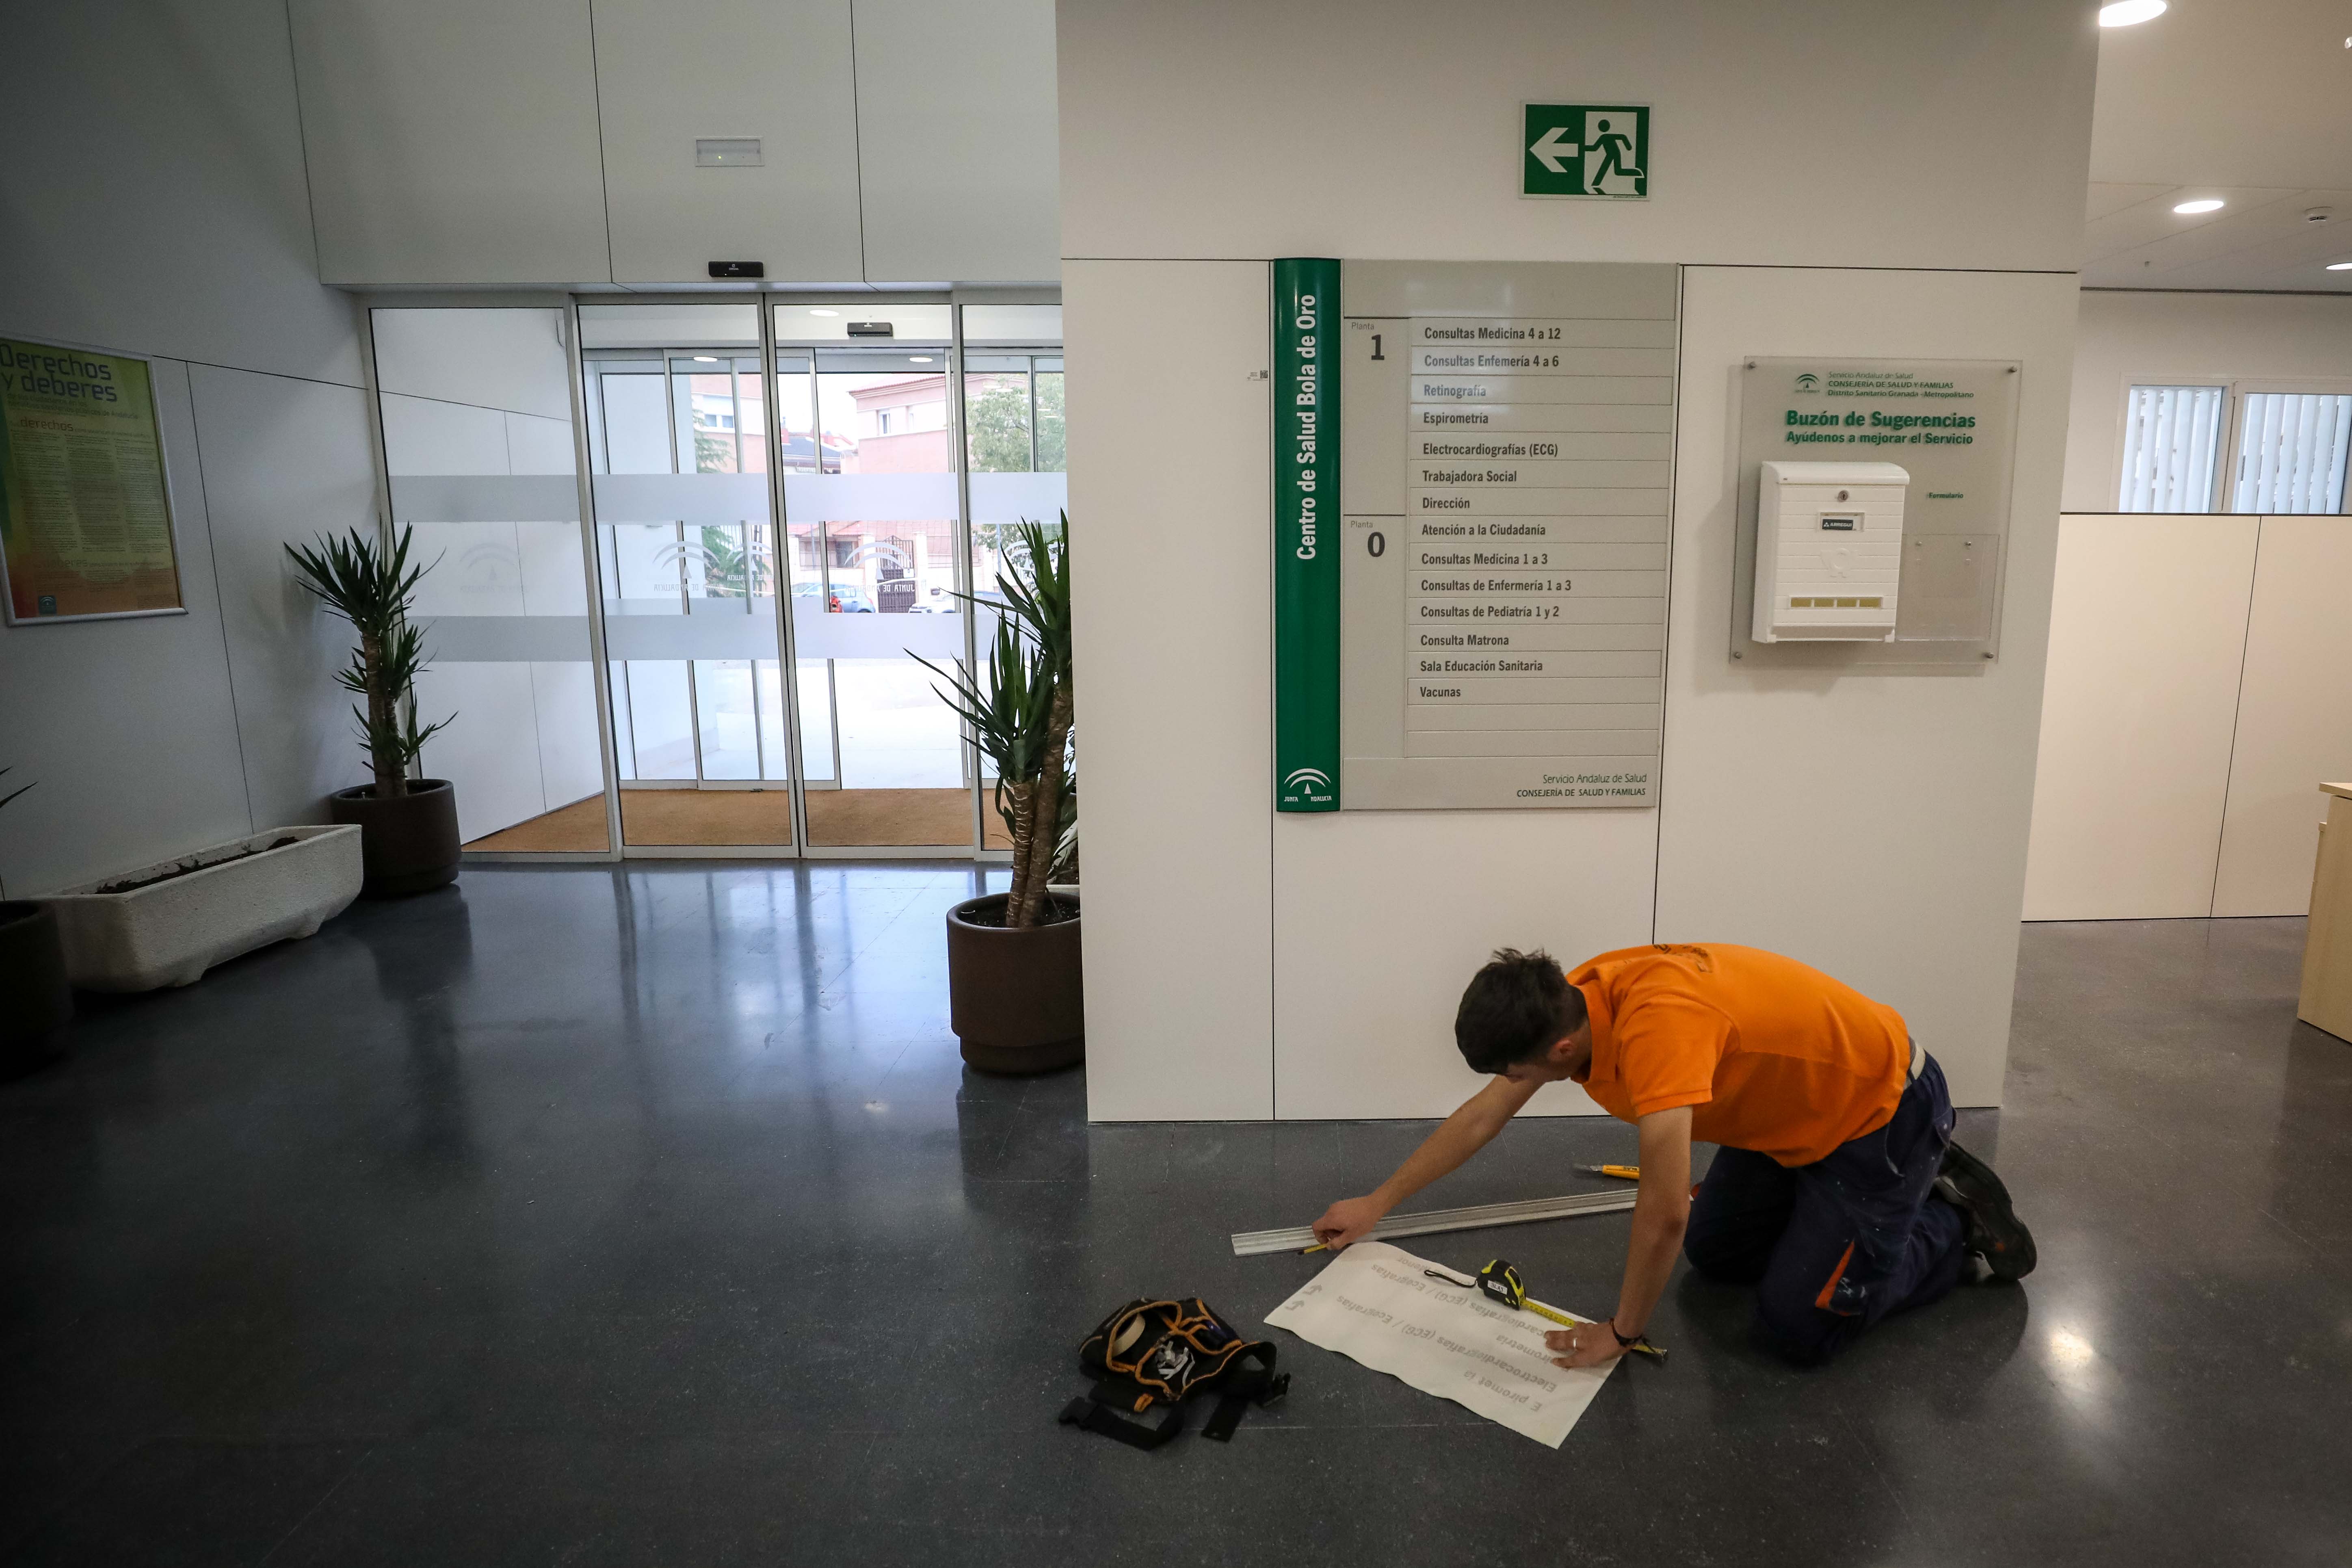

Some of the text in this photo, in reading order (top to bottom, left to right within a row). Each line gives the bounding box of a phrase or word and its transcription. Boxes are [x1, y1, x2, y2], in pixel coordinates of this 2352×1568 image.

[1351, 322, 1374, 330] Planta
[1424, 327, 1561, 340] Consultas Medicina 4 a 12
[1371, 334, 1385, 361] 1
[0, 343, 111, 381] Derechos
[1424, 355, 1559, 367] Consultas Enfemería 4 a 6
[1, 370, 117, 402] y deberes
[1424, 384, 1486, 399] Retinografía
[20, 416, 74, 432] derechos
[1424, 412, 1489, 426] Espirometría
[1787, 410, 1975, 430] Buzón de Sugerencias
[1296, 294, 1316, 560] Centro de Salud Bola de Oro
[1787, 431, 1973, 446] Ayúdenos a mejorar el Servicio
[1423, 443, 1558, 458] Electrocardiografías (ECG)
[1422, 470, 1517, 484] Trabajadora Social
[1423, 497, 1470, 508] Dirección
[1422, 524, 1545, 535] Atención a la Ciudadanía
[1367, 532, 1385, 558] 0
[1422, 553, 1548, 564] Consultas Medicina 1 a 3
[1421, 580, 1571, 591] Consultas de Enfermería 1 a 3
[1421, 606, 1559, 619] Consultas de Pediatría 1 y 2
[1421, 634, 1509, 646] Consulta Matrona
[1421, 660, 1543, 672] Sala Educación Sanitaria
[1420, 686, 1461, 697] Vacunas
[1543, 773, 1647, 784] Servicio Andaluz de Salud
[1517, 789, 1563, 797] CONSEJERÍA
[1579, 788, 1603, 796] SALUD
[1435, 1291, 1467, 1304] (ECG)
[1402, 1324, 1435, 1339] (ECG)
